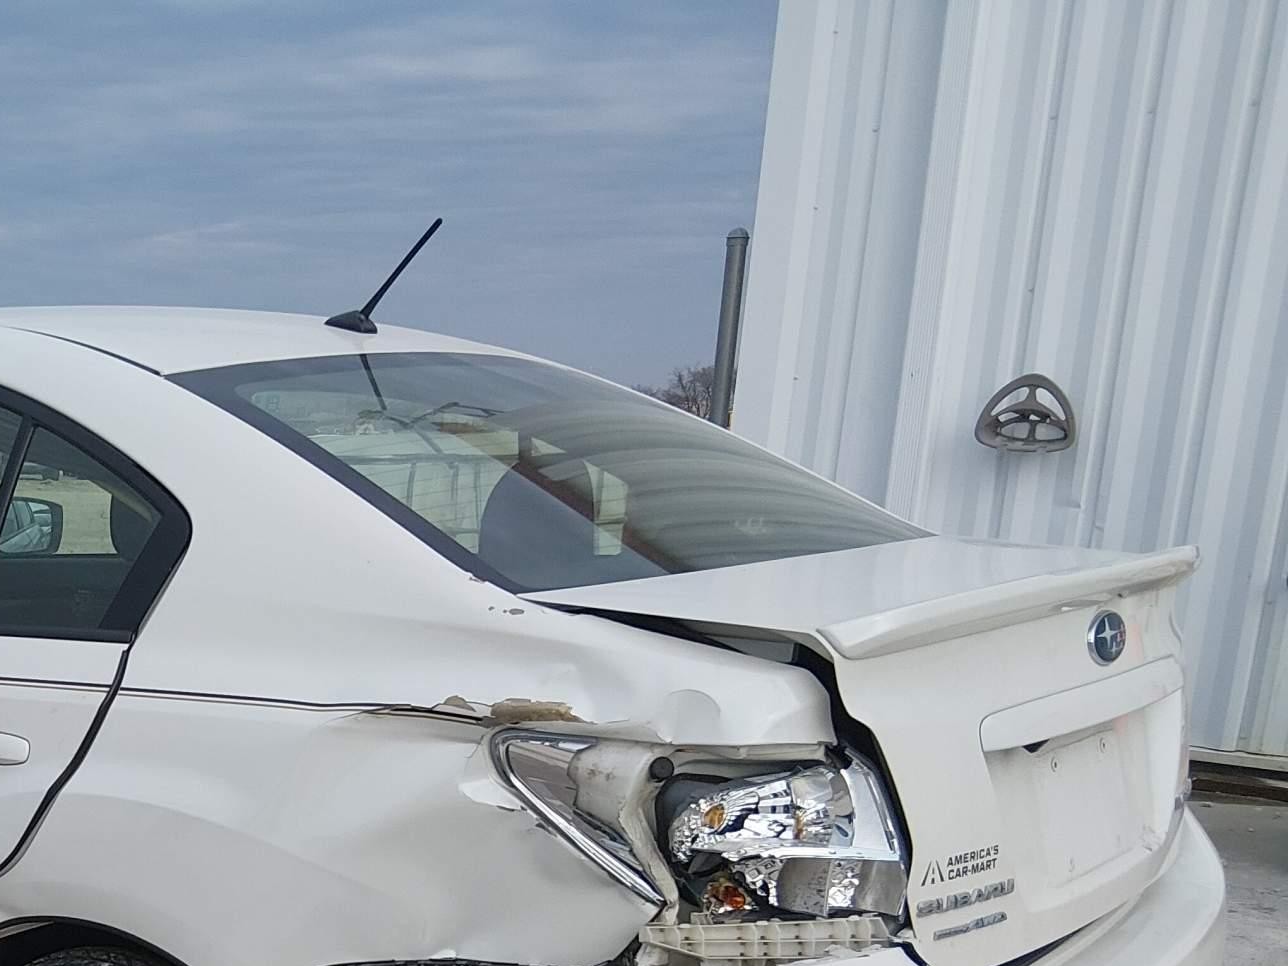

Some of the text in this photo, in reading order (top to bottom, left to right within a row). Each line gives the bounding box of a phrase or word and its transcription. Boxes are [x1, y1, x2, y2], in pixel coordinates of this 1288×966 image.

[946, 844, 1000, 868] AMERICA'S
[947, 857, 999, 881] CAR-MART
[916, 878, 1015, 918] SUBARU
